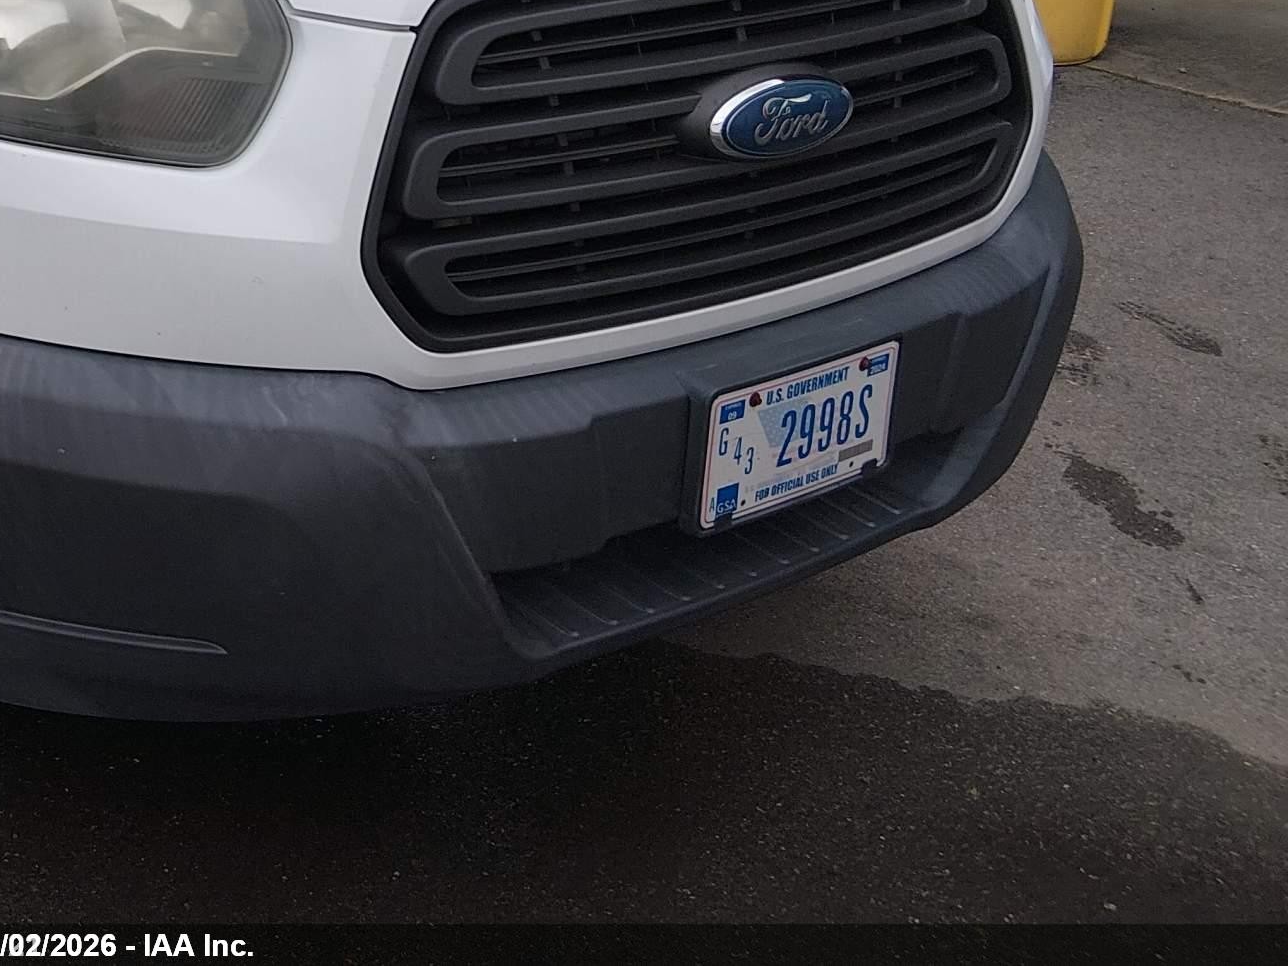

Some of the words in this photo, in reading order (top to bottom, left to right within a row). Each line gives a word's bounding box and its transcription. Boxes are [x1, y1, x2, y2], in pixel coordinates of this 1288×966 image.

[754, 93, 831, 146] Ford
[766, 388, 785, 406] U.S.
[787, 367, 850, 399] GOVERNMENT
[776, 384, 873, 468] 2998S
[755, 489, 770, 502] FOR
[771, 477, 804, 497] OFFICIAL
[805, 472, 820, 486] USE
[820, 464, 838, 480] ONLY
[717, 498, 737, 514] GSA
